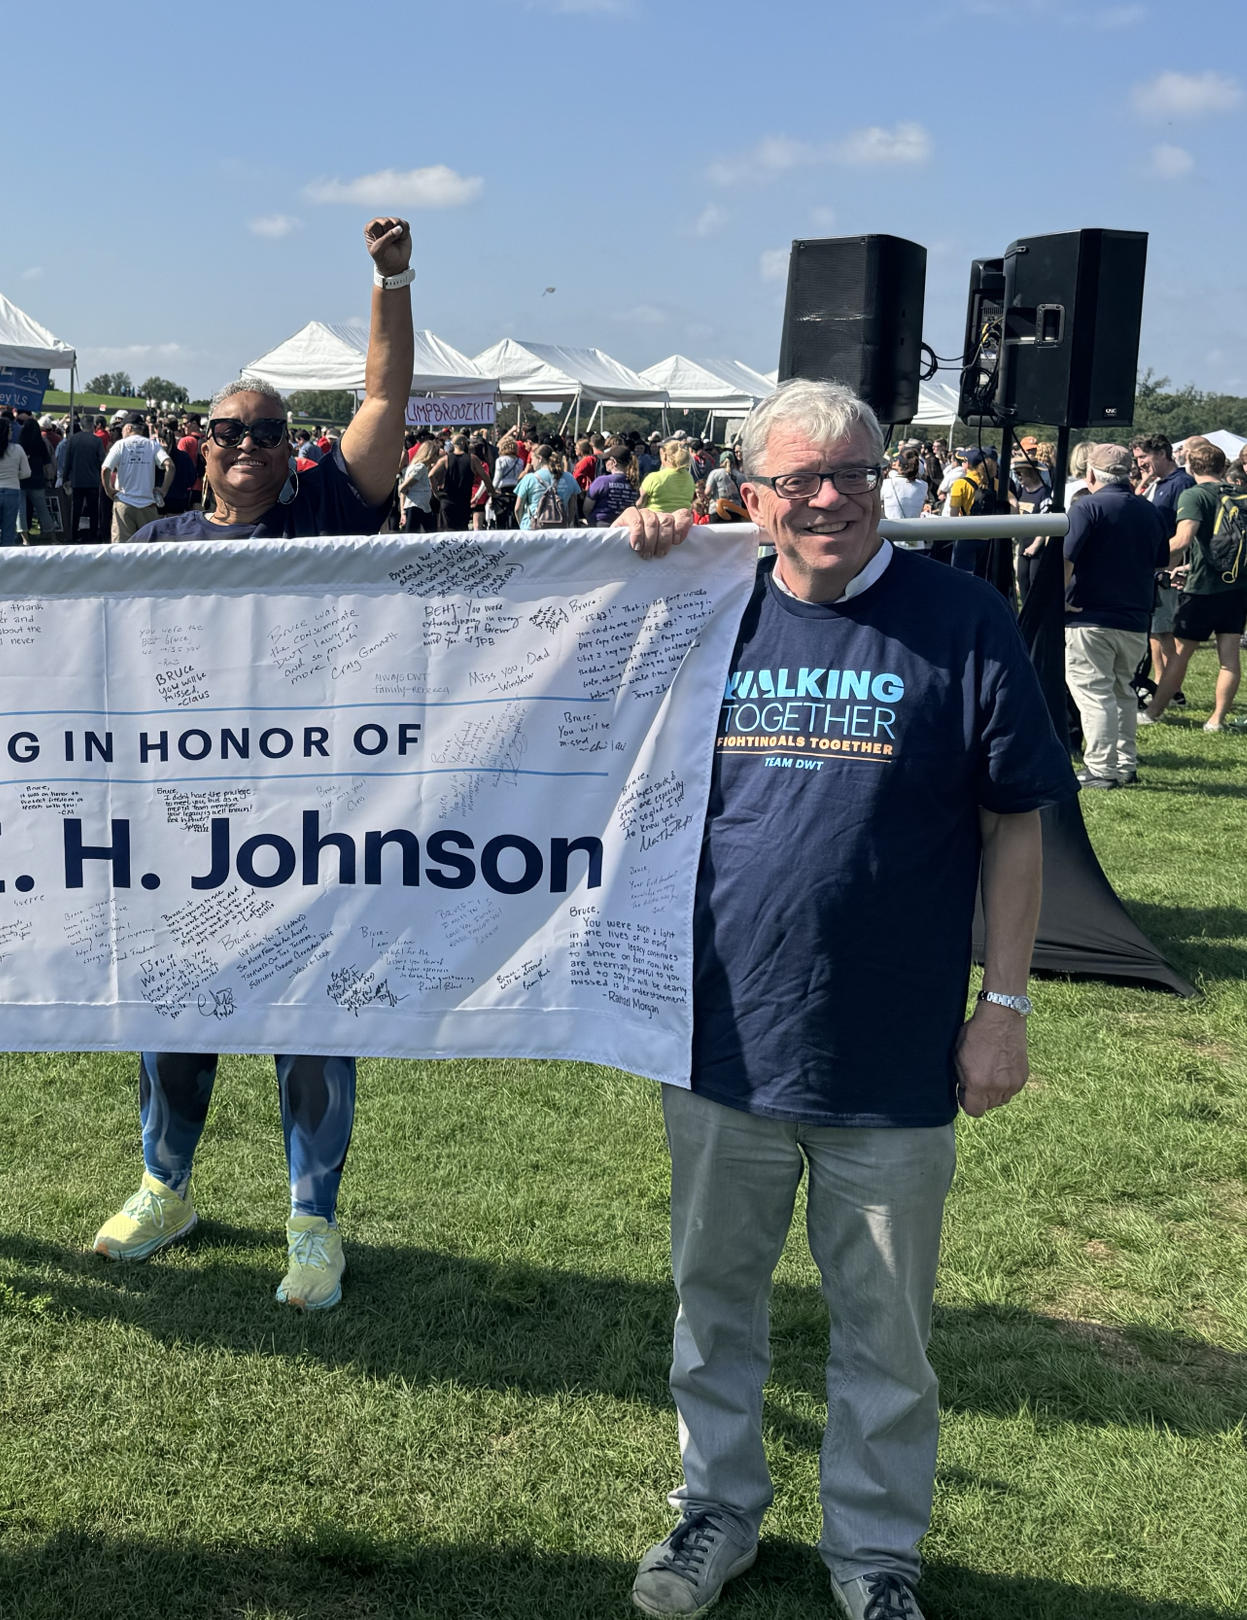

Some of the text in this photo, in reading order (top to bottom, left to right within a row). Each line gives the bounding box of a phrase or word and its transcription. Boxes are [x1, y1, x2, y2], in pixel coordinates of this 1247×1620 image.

[10, 603, 44, 612] thank
[314, 605, 338, 621] was
[13, 615, 35, 624] and
[27, 625, 42, 633] the
[270, 646, 290, 658] the
[284, 633, 357, 677] and so much
[469, 671, 496, 686] Miss
[526, 647, 550, 665] Dad
[724, 667, 905, 703] WALKING
[722, 702, 896, 740] TOGETHER
[558, 722, 610, 738] You will be
[64, 730, 114, 763] IN
[139, 726, 330, 764] HONOR
[353, 723, 421, 756] OF
[809, 737, 894, 755] TOGETHER
[764, 757, 824, 771] TEAM DWT
[63, 817, 161, 891] H.
[191, 809, 604, 895] Johnson
[583, 917, 601, 928] You
[607, 920, 632, 931] were
[569, 931, 579, 939] in
[583, 928, 602, 937] the
[608, 930, 629, 941] lives
[633, 934, 640, 942] of
[568, 950, 580, 958] to
[586, 949, 617, 959] shine
[569, 939, 590, 948] and
[598, 941, 621, 949] your
[647, 949, 679, 962] continues
[570, 960, 586, 968] are
[593, 960, 631, 974] eternally
[655, 971, 664, 979] to
[666, 973, 680, 982] you
[570, 968, 591, 977] and
[596, 970, 609, 978] to
[613, 971, 626, 984] say
[651, 980, 661, 989] be
[663, 982, 688, 997] dearly
[570, 978, 608, 987] missed
[632, 997, 660, 1020] Morgan
